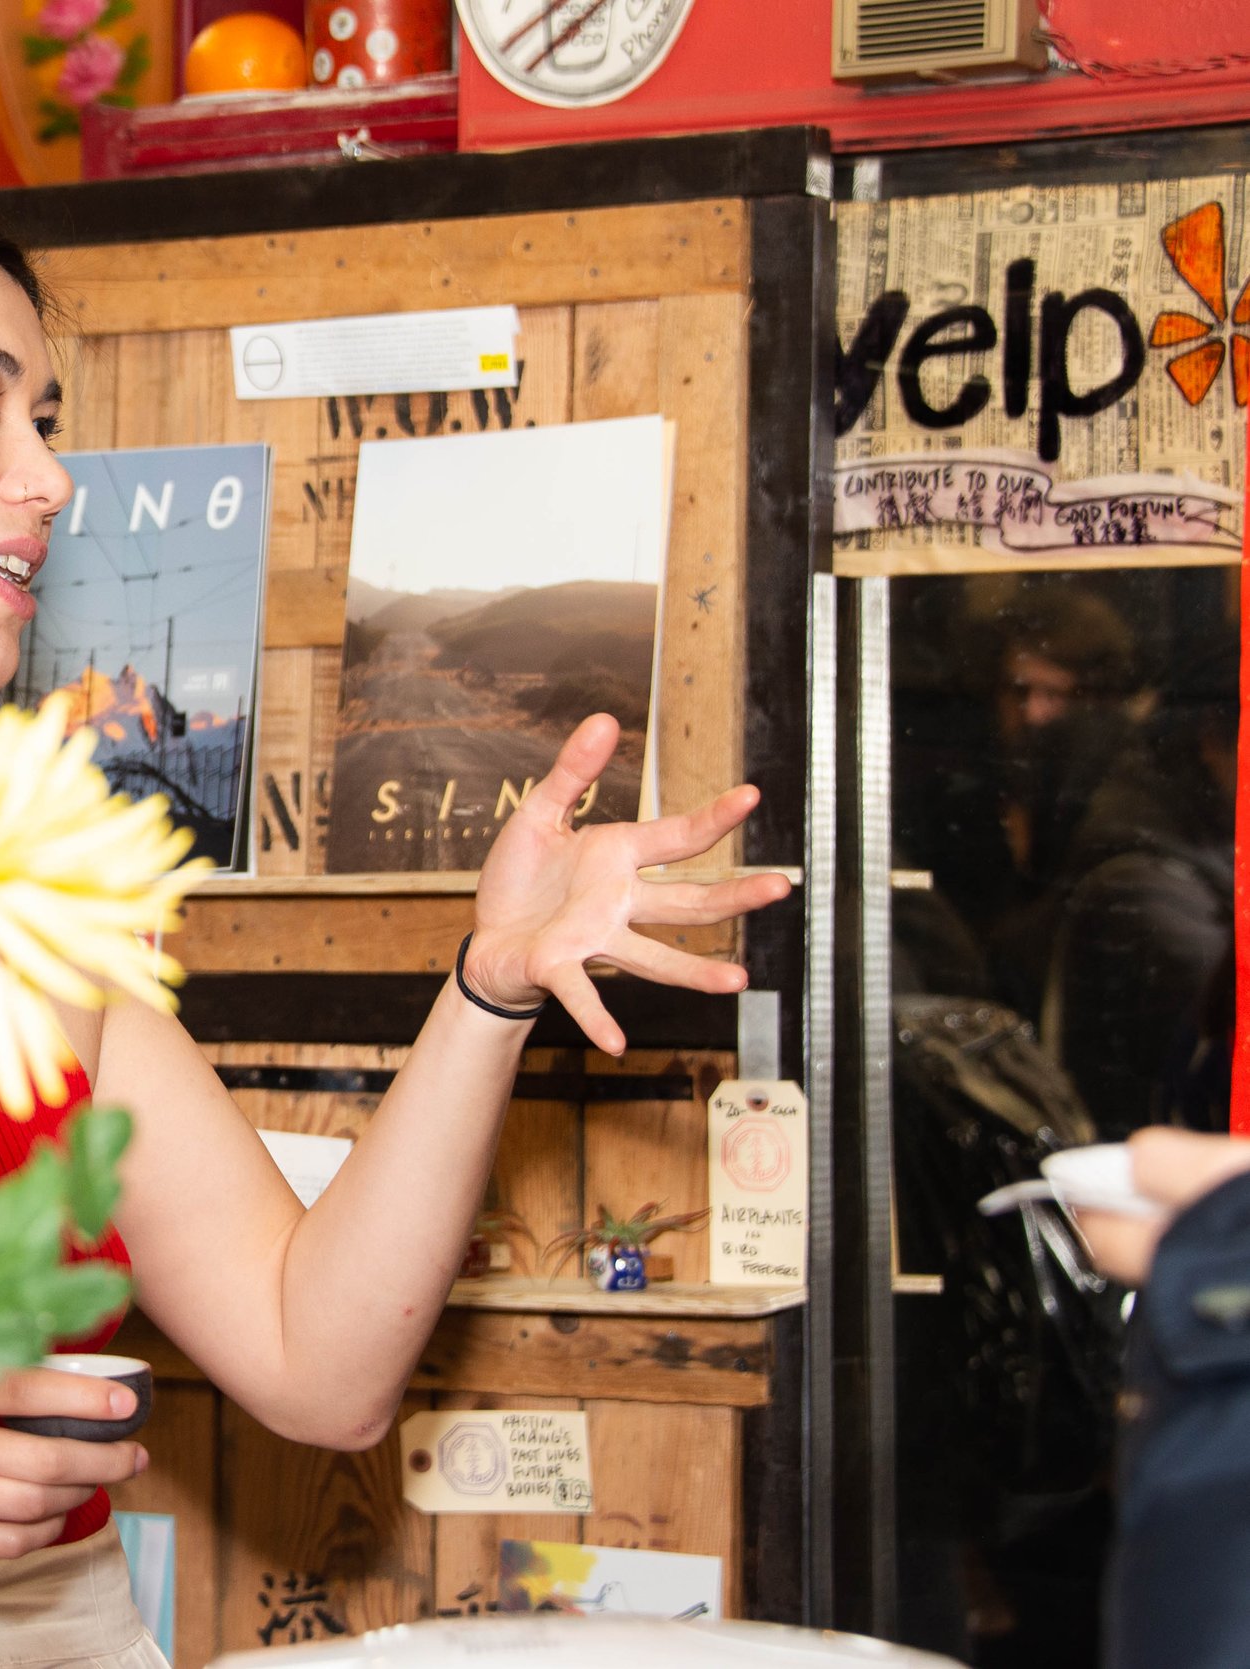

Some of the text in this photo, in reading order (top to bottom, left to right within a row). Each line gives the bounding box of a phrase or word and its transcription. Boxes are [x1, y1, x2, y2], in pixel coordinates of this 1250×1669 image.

[834, 257, 1145, 462] yelp
[844, 465, 1035, 497] CONTRIBUTE TO OUR
[1054, 497, 1187, 527] GOOD FORTUNE
[721, 1203, 804, 1226] AIRPLANTS
[739, 1260, 800, 1277] FEEDERS
[511, 1448, 582, 1462] PAST LIVES
[513, 1464, 564, 1480] FUTURE
[505, 1481, 552, 1497] BODIES
